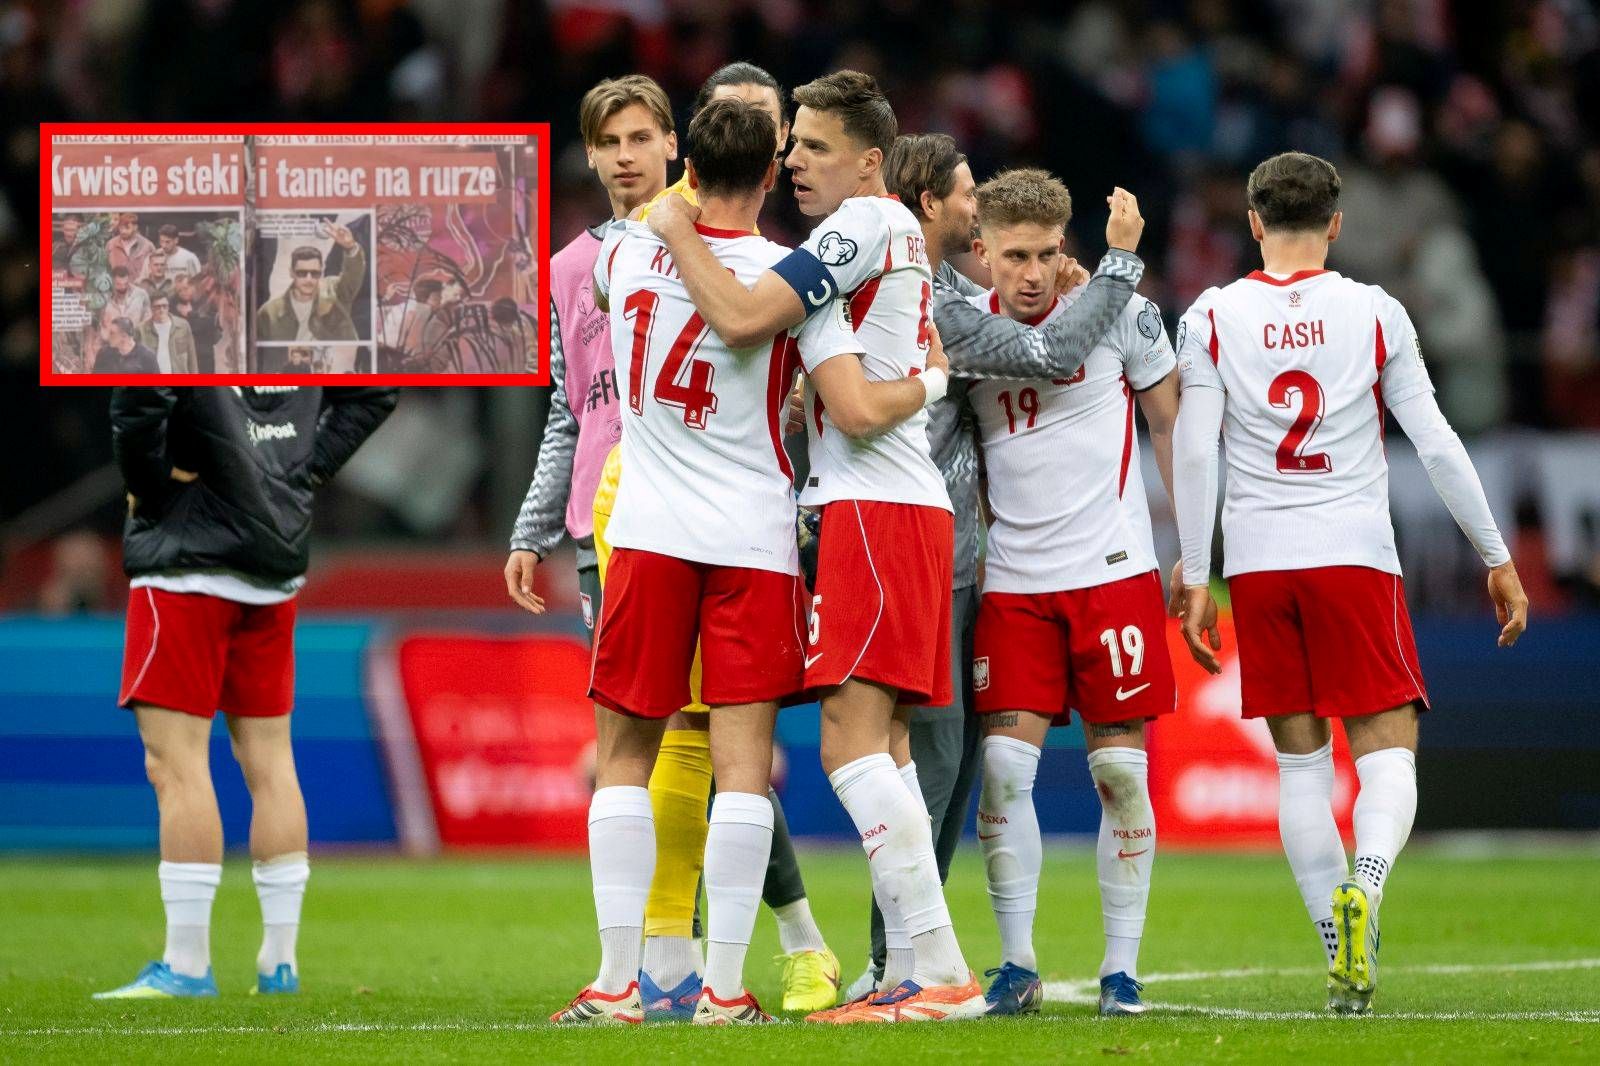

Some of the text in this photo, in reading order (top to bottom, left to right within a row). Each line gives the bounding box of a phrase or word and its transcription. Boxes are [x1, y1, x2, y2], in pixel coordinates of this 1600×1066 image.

[807, 278, 832, 306] C
[623, 288, 719, 430] 14
[1263, 319, 1325, 350] CASH
[997, 386, 1041, 435] 19
[1268, 369, 1333, 475] 2
[1099, 624, 1145, 678] 19
[1112, 828, 1152, 839] POLSKA
